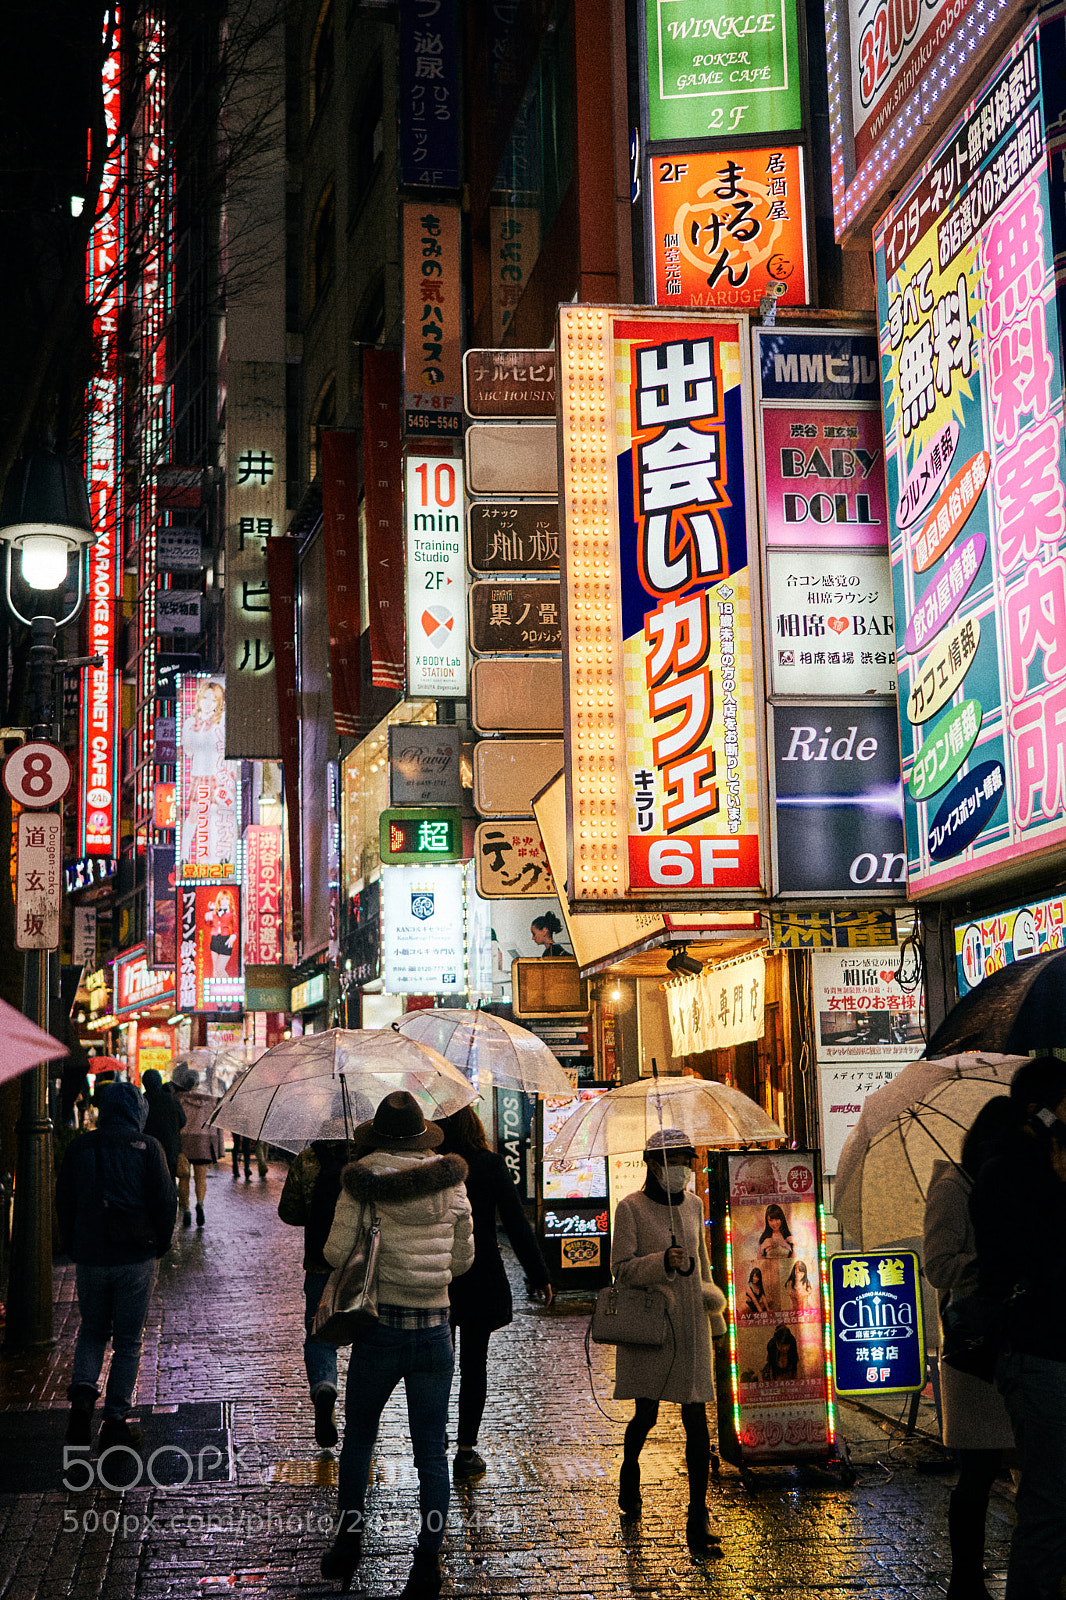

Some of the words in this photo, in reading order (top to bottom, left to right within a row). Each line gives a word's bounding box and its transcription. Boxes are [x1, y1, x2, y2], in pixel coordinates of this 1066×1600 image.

[667, 14, 776, 40] WINKLE
[692, 51, 751, 68] POKER
[677, 72, 723, 90] GAME
[729, 65, 772, 83] CAFÉ
[433, 86, 451, 120] ひろ
[707, 105, 749, 131] 2F
[411, 85, 428, 162] クリニック
[419, 171, 444, 184] 4F
[659, 162, 689, 184] 2F
[765, 153, 790, 222] 居酒屋
[691, 160, 760, 290] まるげん
[664, 233, 682, 296] 個室完備
[690, 289, 767, 306] MARUGE
[888, 258, 934, 351] すべて
[775, 354, 877, 384] MMビル
[900, 273, 972, 438] 無料
[790, 424, 818, 438] 渋谷
[823, 426, 859, 439] 道玄坂
[780, 447, 880, 480] BABY
[899, 426, 954, 524] グルメ情報
[415, 462, 456, 508] 10
[413, 512, 460, 533] min
[482, 508, 518, 518] スナック
[783, 492, 881, 525] DOLL
[414, 540, 460, 554] Training
[414, 551, 450, 563] Studio
[93, 532, 111, 621] KARAOKE
[424, 571, 446, 590] 2F
[637, 335, 721, 836] 出会いカフェ
[786, 574, 861, 587] 合コン感覚の
[914, 538, 978, 646] 飲み屋情報
[807, 591, 879, 604] 相席ラウンジ
[776, 614, 825, 637] 相席
[852, 615, 895, 636] BAR
[421, 667, 455, 678] STATION
[800, 651, 855, 665] 相席酒場
[911, 620, 976, 719] カフェ情報
[92, 639, 109, 732] INTERNET
[781, 726, 878, 761] Ride
[913, 702, 978, 797] タウン情報
[21, 752, 53, 797] 8
[91, 736, 108, 787] CAFE
[634, 770, 655, 832] キラリ
[929, 766, 1003, 853] プレイスポット情報
[419, 821, 449, 851] 超
[46, 826, 59, 896] Dougen-zaka
[648, 838, 740, 886] 6F
[24, 826, 47, 937] 道玄坂
[259, 832, 277, 964] 渋谷の大人の遊び
[1033, 901, 1065, 931] タバコ
[981, 918, 1008, 946] トイレ
[985, 944, 1005, 978] OK
[443, 974, 456, 983] 5F
[843, 969, 878, 986] 相席
[827, 995, 916, 1010] 女性のお客様
[503, 1097, 520, 1185] CRATOS
[842, 1259, 905, 1288] 麻雀
[839, 1295, 912, 1328] China
[855, 1329, 897, 1339] 麻雀チャイナ
[856, 1346, 898, 1361] 渋谷店
[866, 1367, 890, 1382] 5F
